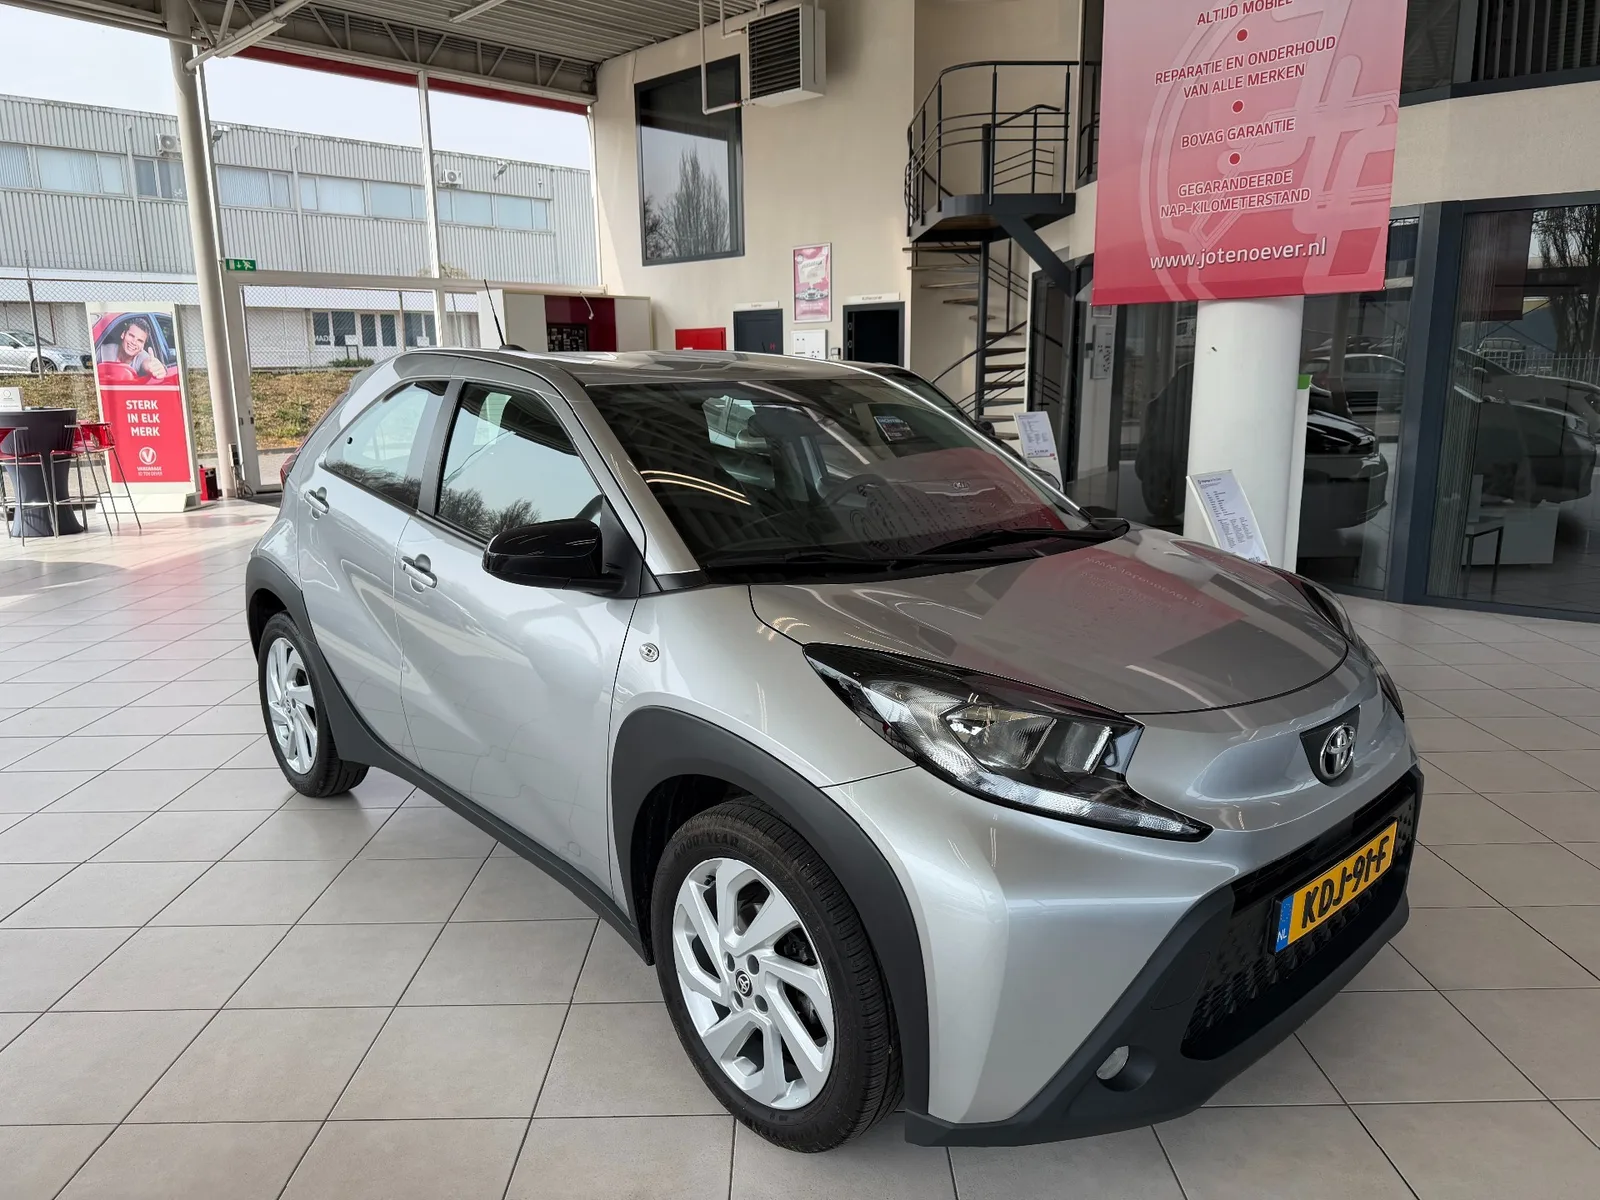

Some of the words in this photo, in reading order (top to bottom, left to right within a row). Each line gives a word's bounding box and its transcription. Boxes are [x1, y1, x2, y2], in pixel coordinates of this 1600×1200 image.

[1196, 5, 1239, 26] ALTIJD
[1155, 60, 1223, 85] REPARATIE
[1226, 55, 1244, 70] EN
[1247, 36, 1336, 66] ONDERHOUD
[1183, 83, 1209, 99] VAN
[1212, 76, 1243, 94] ALLE
[1247, 64, 1306, 87] MERKEN
[1181, 129, 1224, 149] BOVAG
[1227, 118, 1295, 141] GARANTIE
[1178, 170, 1292, 197] GEGARANDEERDE
[1160, 189, 1310, 218] NAP-KILOMETERSTAND
[1150, 237, 1327, 270] www.jotenoever.nl
[125, 399, 158, 410] STERK
[127, 413, 139, 424] IN
[141, 413, 160, 424] ELK
[130, 426, 160, 437] MERK
[1276, 928, 1288, 943] NL
